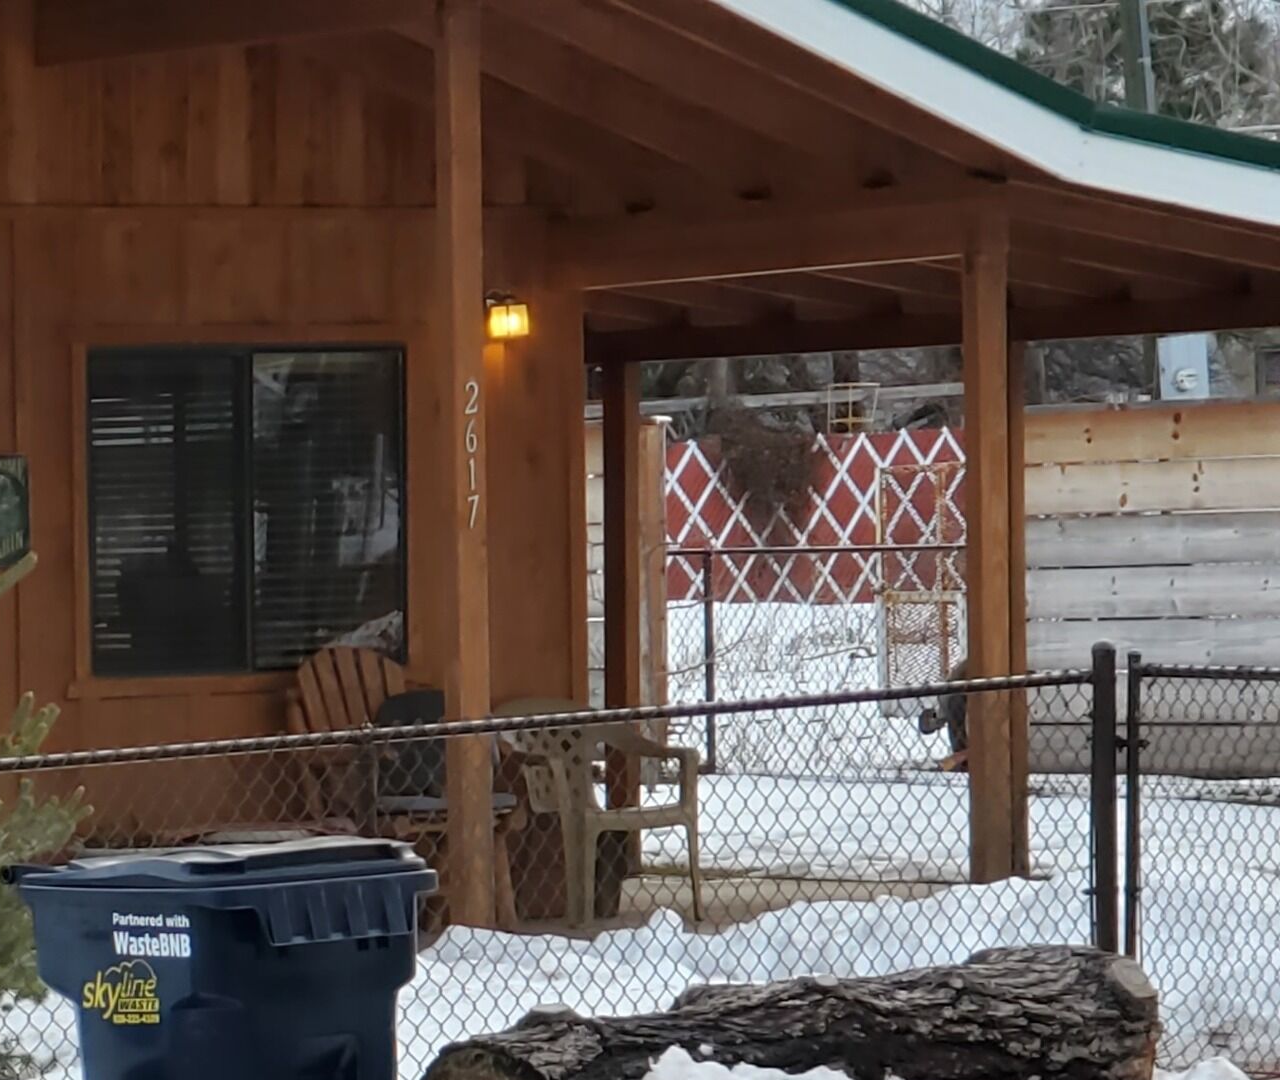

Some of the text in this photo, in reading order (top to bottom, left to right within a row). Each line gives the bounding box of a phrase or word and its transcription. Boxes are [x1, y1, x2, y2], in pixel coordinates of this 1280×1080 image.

[464, 380, 480, 529] 2617
[112, 912, 190, 928] Partnered with
[113, 931, 191, 957] WasteBNB
[119, 998, 158, 1011] WASTE
